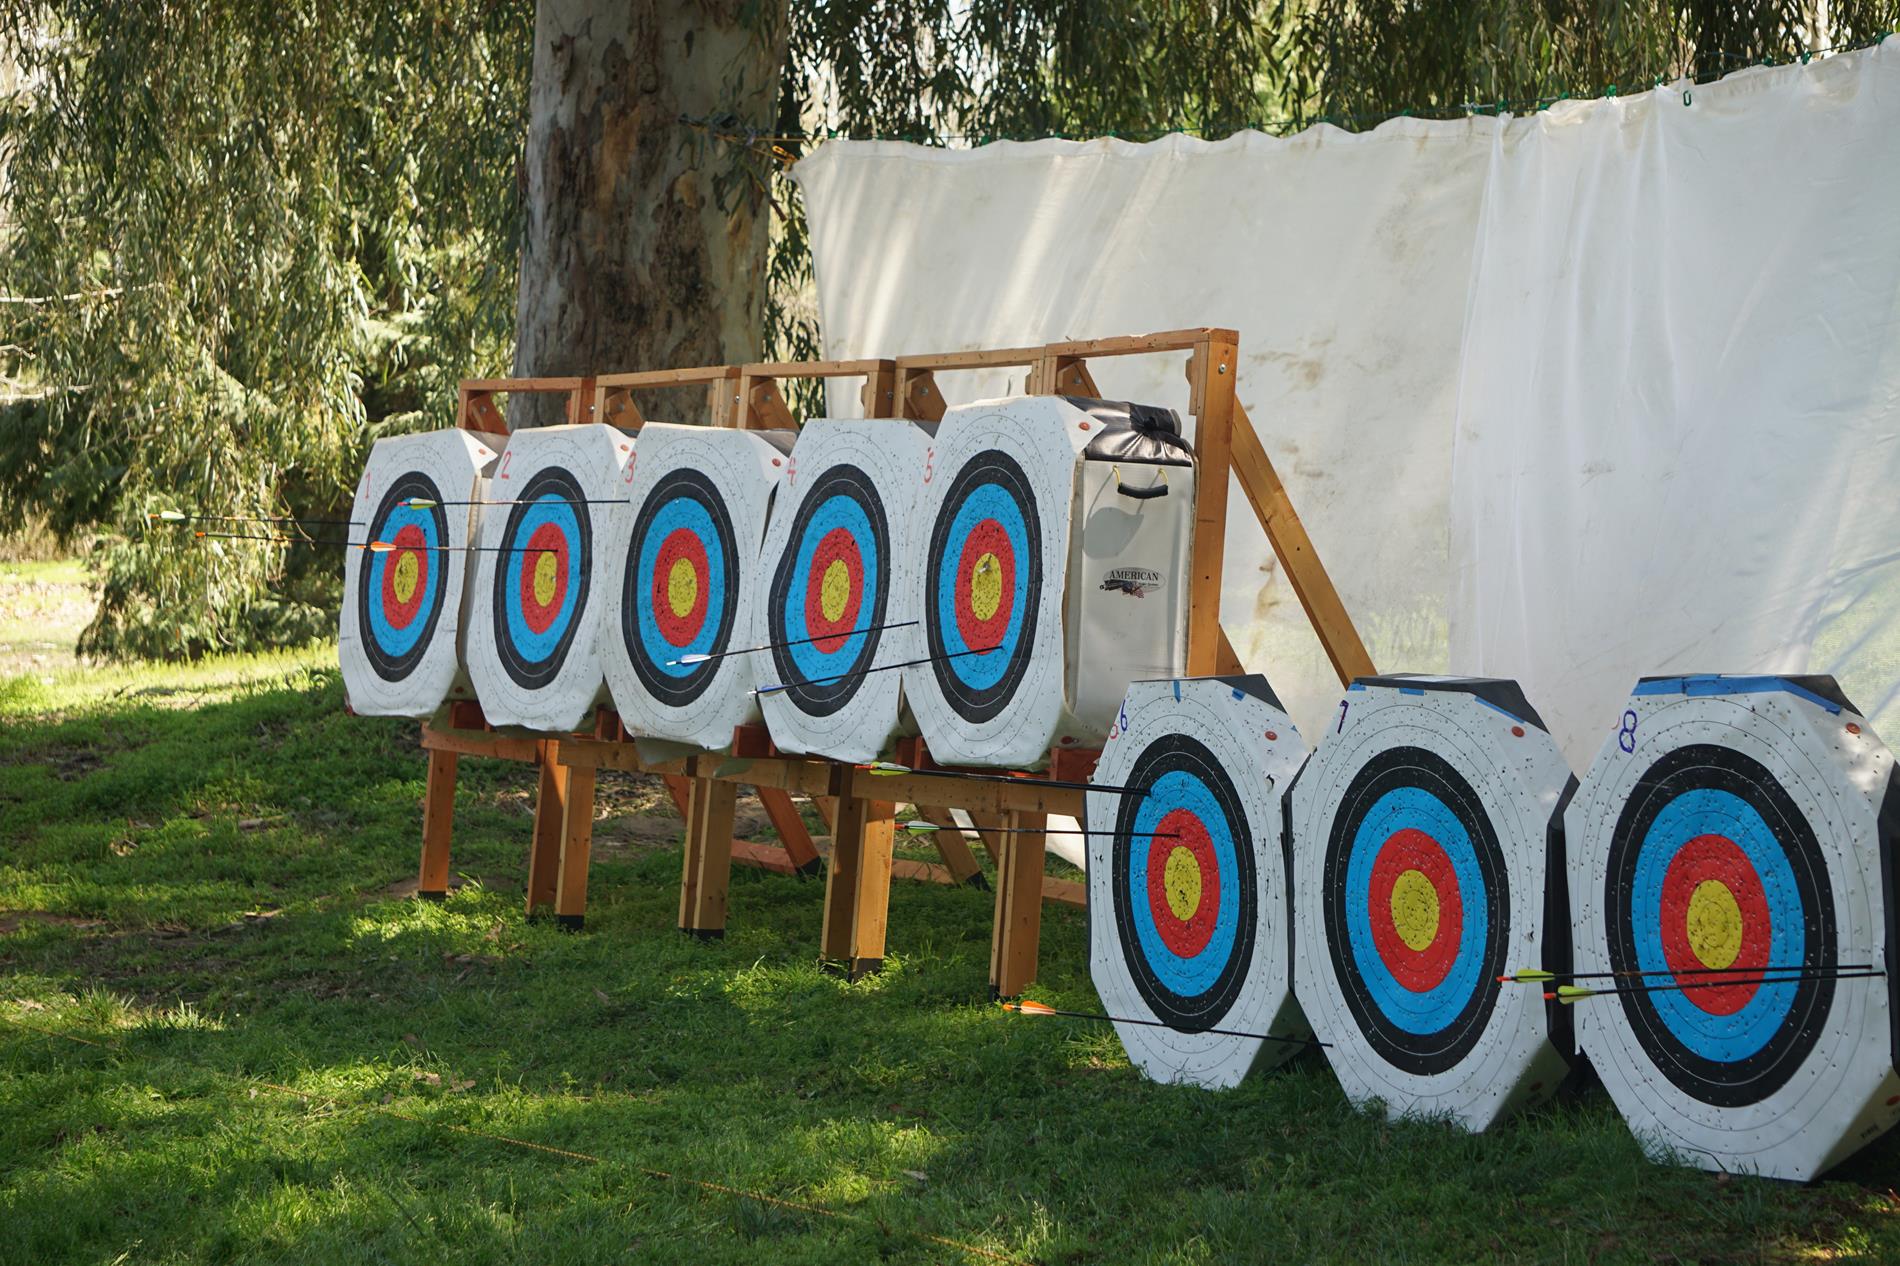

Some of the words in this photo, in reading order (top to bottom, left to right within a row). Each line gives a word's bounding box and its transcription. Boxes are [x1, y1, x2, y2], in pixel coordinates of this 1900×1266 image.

[500, 450, 512, 479] 2
[624, 451, 637, 483] 3
[787, 456, 797, 486] 4
[924, 446, 934, 483] 5
[365, 472, 371, 499] 1
[1109, 570, 1160, 582] AMERICAN
[1120, 699, 1128, 732] 6
[1618, 709, 1638, 754] 8
